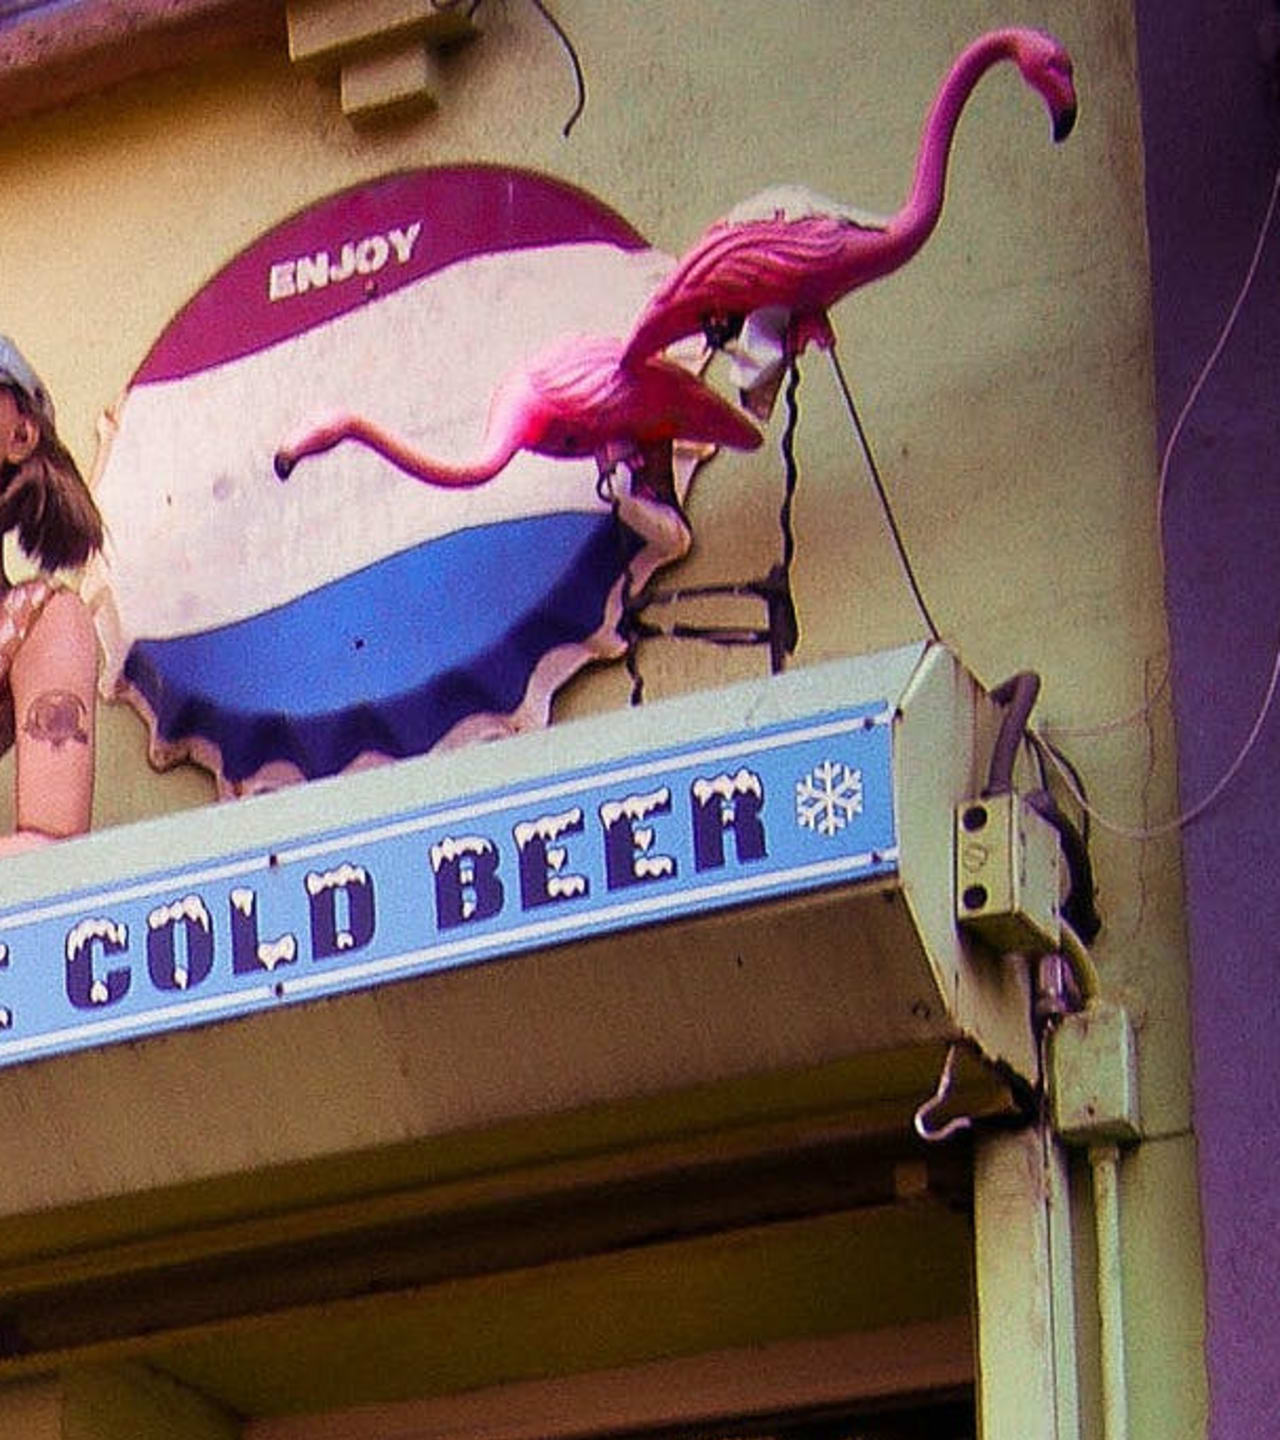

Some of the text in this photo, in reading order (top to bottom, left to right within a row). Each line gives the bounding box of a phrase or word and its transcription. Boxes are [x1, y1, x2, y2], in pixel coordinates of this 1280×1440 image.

[268, 222, 426, 302] ENJOY
[63, 863, 378, 1006] COLD
[429, 768, 769, 930] BEER
